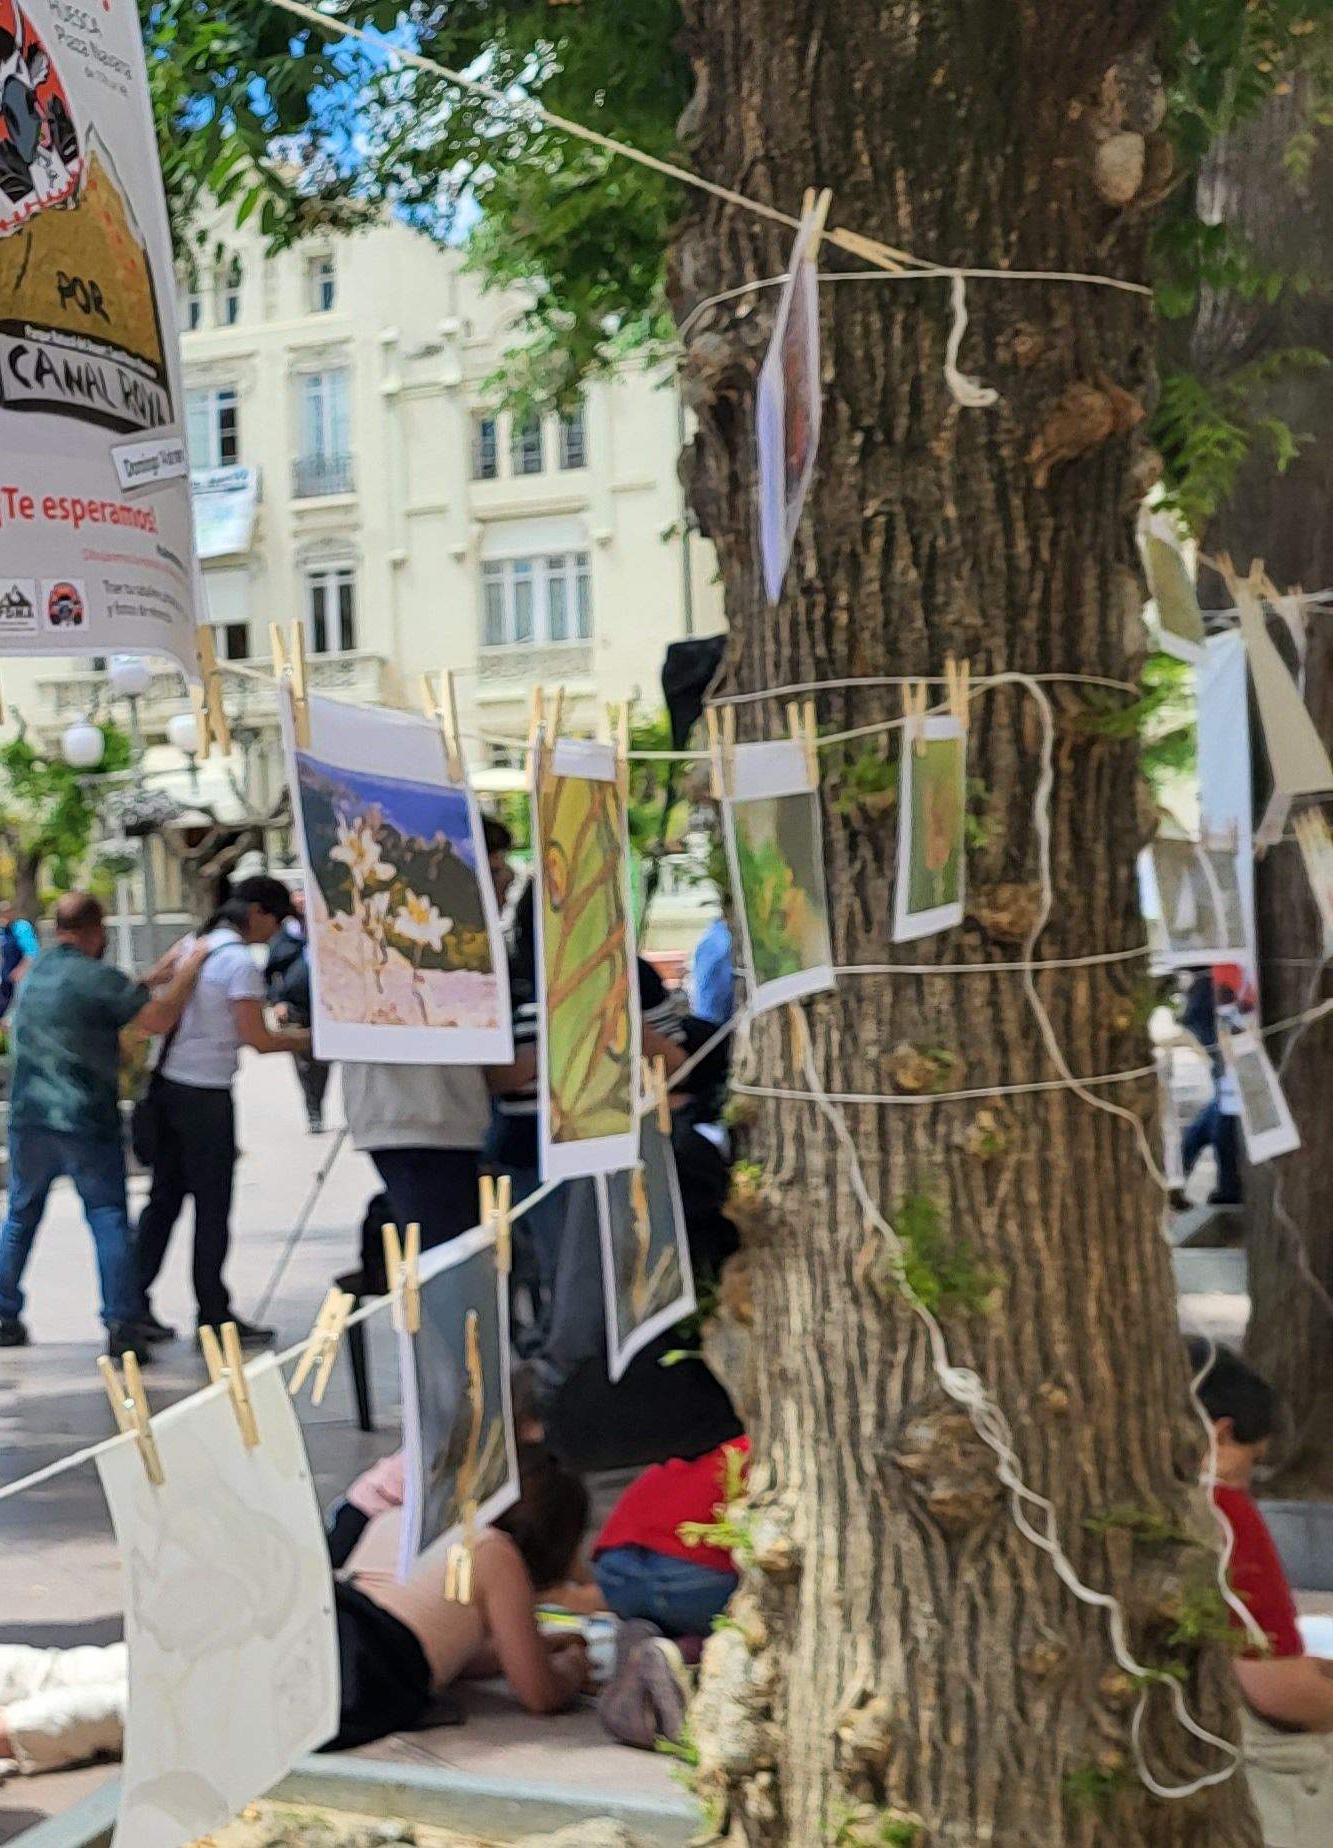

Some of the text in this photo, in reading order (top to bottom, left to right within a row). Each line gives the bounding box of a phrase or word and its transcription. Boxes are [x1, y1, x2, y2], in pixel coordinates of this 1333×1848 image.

[56, 269, 111, 324] POR
[8, 344, 117, 409] CANAL
[42, 494, 159, 534] esperamos!
